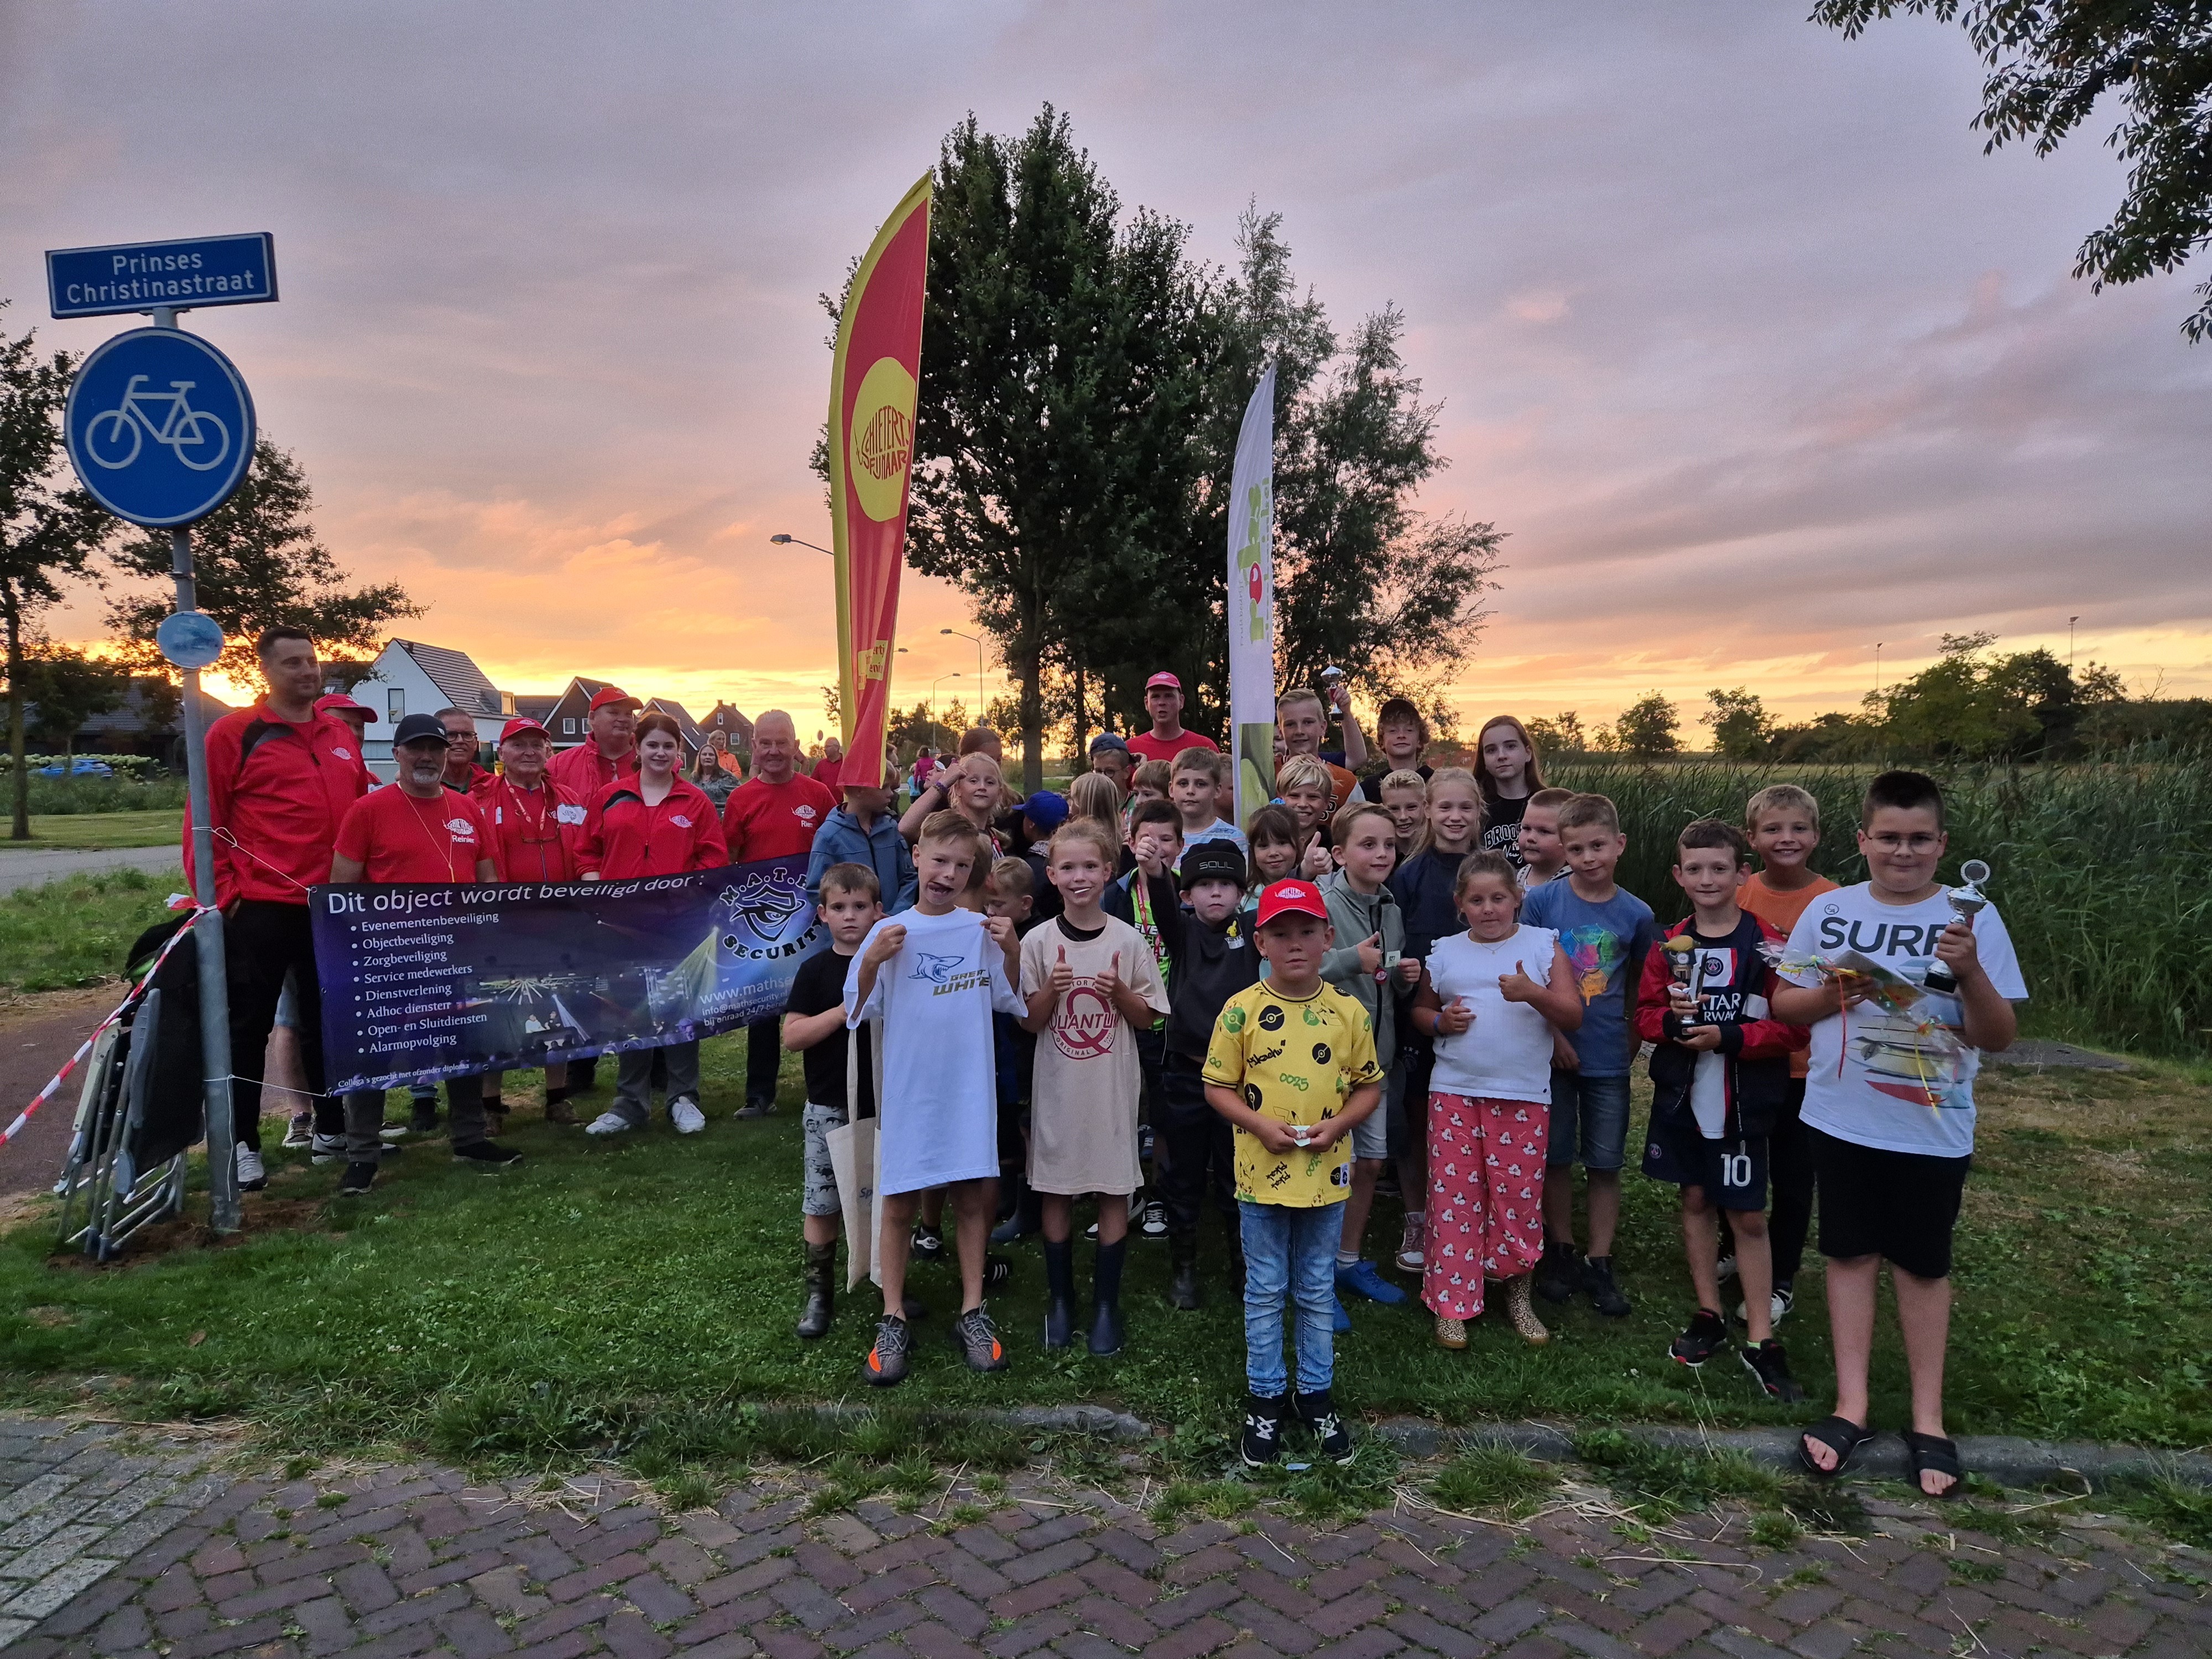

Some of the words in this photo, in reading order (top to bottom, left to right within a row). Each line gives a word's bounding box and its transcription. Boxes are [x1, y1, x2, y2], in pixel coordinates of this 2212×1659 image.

[112, 253, 203, 275] Prinses
[67, 269, 255, 304] Christinastraat
[869, 449, 907, 481] FIJNAAR
[1484, 823, 1520, 851] BROO
[1199, 860, 1234, 870] SOUL
[328, 891, 366, 914] Dit
[373, 889, 452, 914] object
[461, 885, 533, 905] wordt
[539, 881, 638, 899] beveiligd
[361, 912, 499, 932] Evenementenbeveiliging
[362, 932, 454, 951] Objectbeveiliging
[363, 951, 447, 967] Zorgbeveiliging
[364, 972, 404, 984] Service
[407, 964, 473, 980] medewerkers
[365, 983, 452, 1002] Dienstverlening
[700, 975, 795, 1005] www.mathse
[702, 989, 787, 1016] info@mathsecurity.nl
[1703, 993, 1741, 1010] TAR
[367, 1005, 402, 1019] Adhoc
[704, 1018, 715, 1027] bij
[717, 1010, 744, 1023] onraad
[747, 1005, 764, 1015] 24/7
[1704, 1010, 1736, 1022] RWAY
[368, 1025, 401, 1038] Open-
[404, 1022, 417, 1031] en
[419, 1013, 487, 1030] Sluitdiensten
[369, 1034, 457, 1053] Alarmopvolging
[1056, 1037, 1091, 1055] ORIGINAL
[372, 1072, 398, 1084] gezocht
[399, 1071, 411, 1079] met
[442, 1063, 469, 1073] diploma
[1279, 1072, 1309, 1092] 0025
[1720, 1154, 1751, 1187] 10
